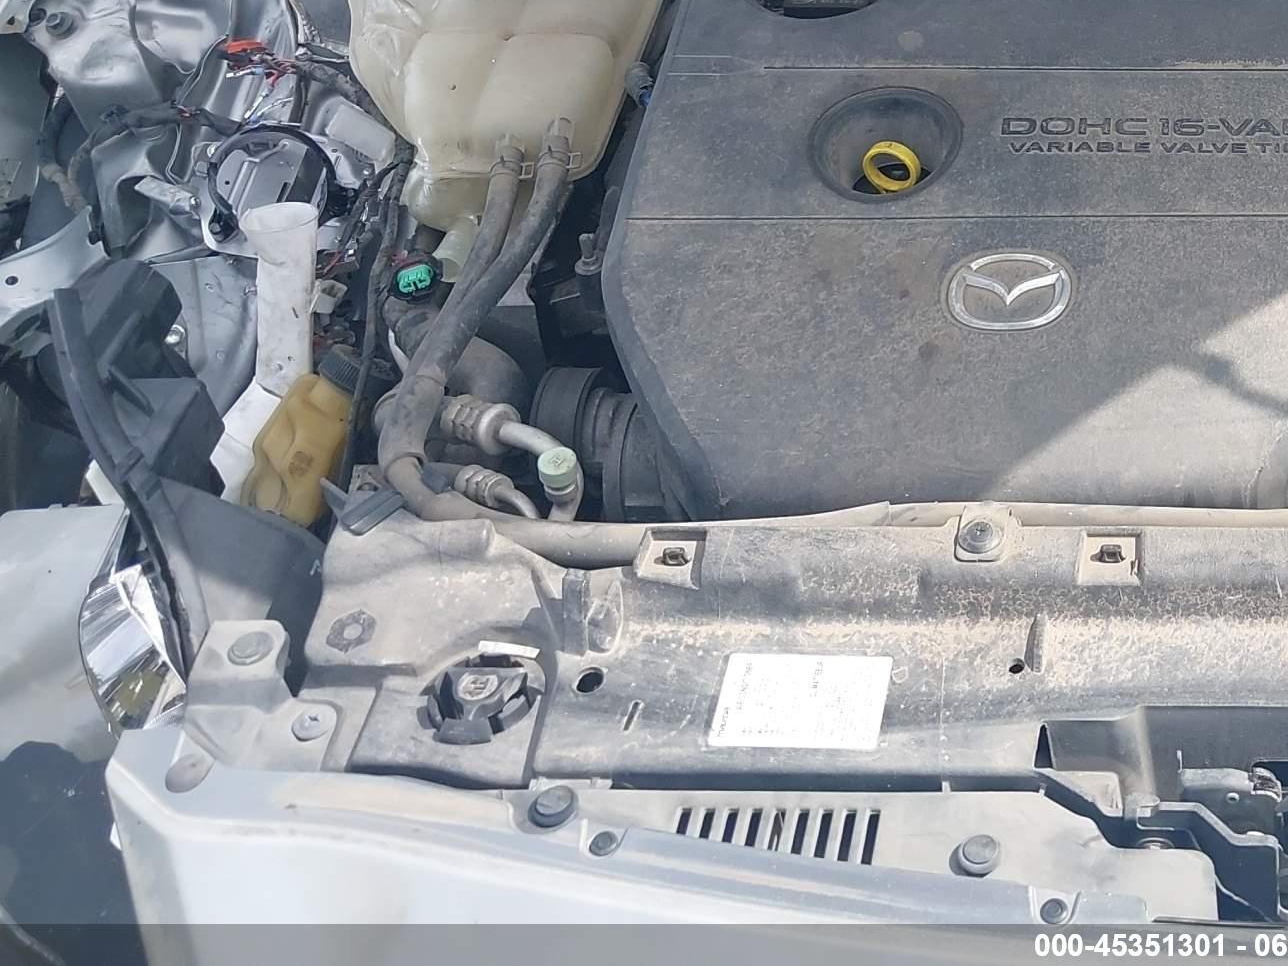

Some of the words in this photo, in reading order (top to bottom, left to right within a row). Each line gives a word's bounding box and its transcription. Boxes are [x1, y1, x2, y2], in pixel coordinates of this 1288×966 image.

[1000, 116, 1149, 136] DOHC
[1008, 141, 1151, 154] VARIABLE
[1160, 141, 1248, 154] VALVE
